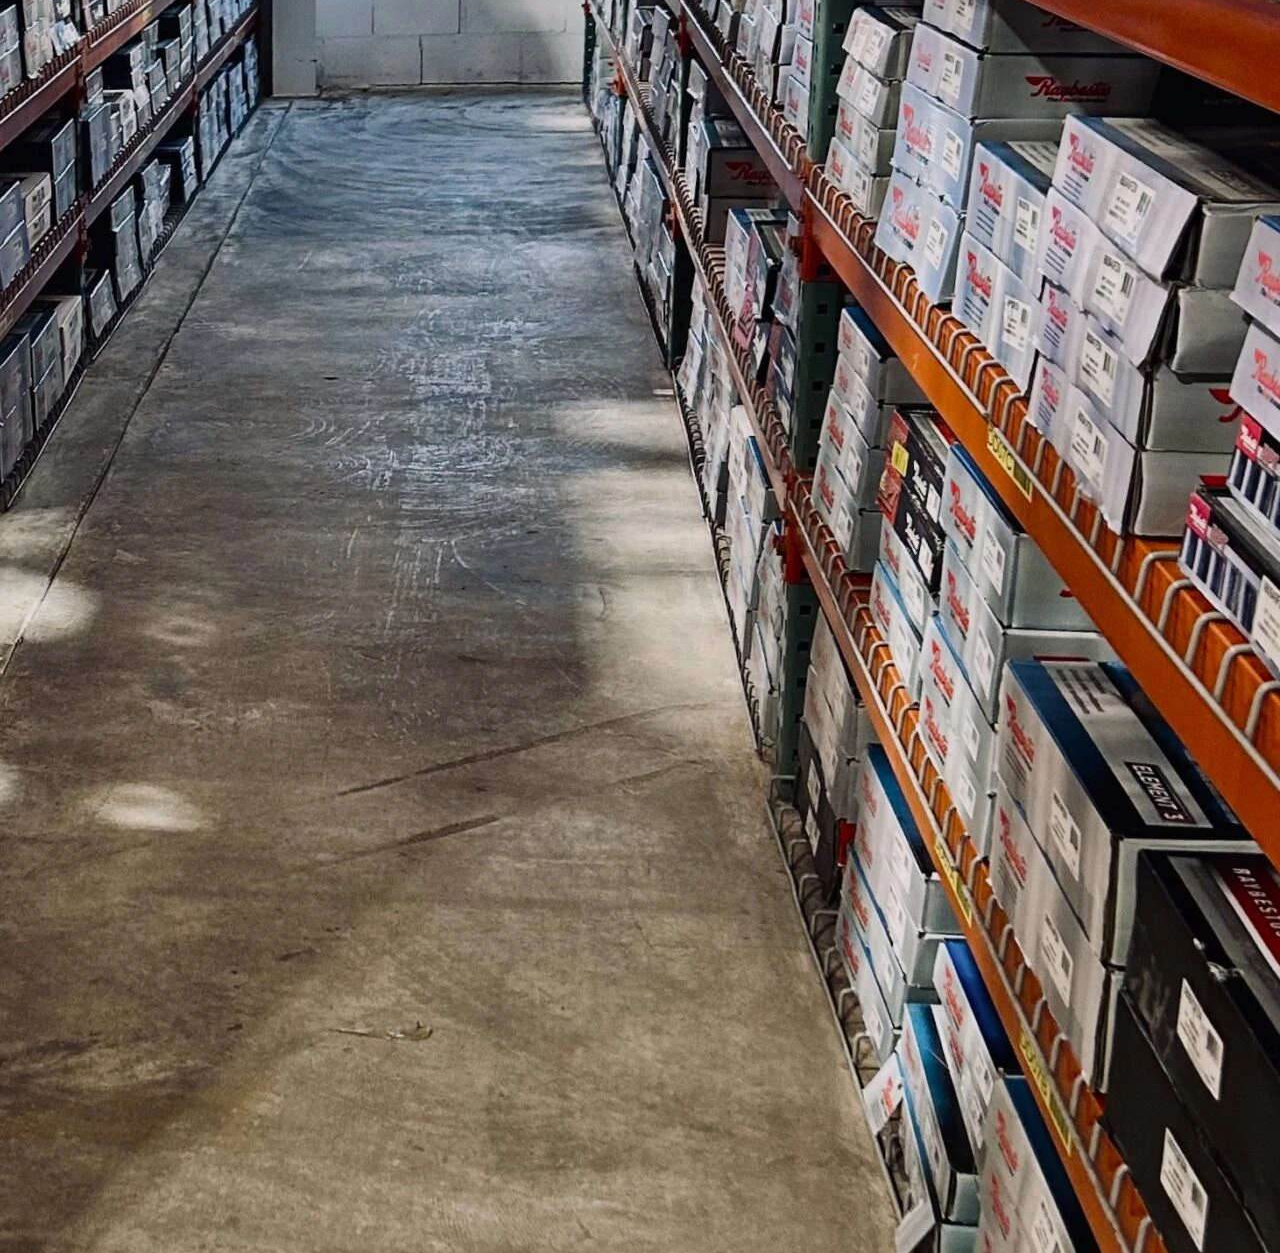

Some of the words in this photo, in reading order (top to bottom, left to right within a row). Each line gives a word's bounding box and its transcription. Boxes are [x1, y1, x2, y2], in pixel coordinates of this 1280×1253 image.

[1025, 76, 1112, 101] Raybestos
[1131, 764, 1178, 812] ELEMENT
[1163, 812, 1185, 822] 3
[1232, 867, 1280, 938] RAYBESTO
